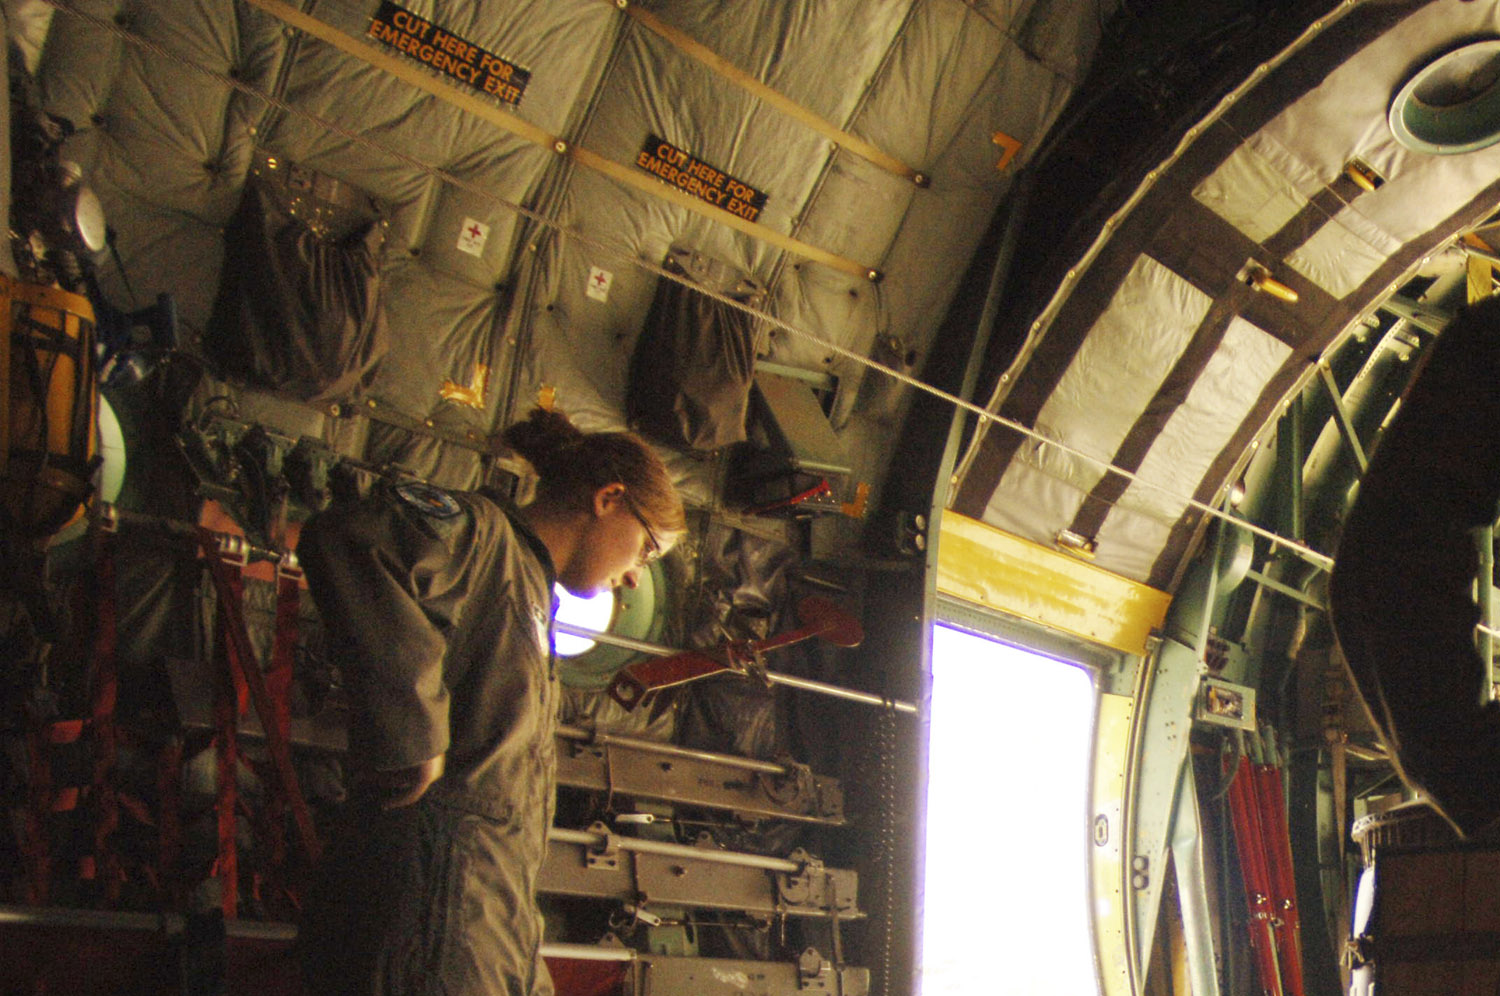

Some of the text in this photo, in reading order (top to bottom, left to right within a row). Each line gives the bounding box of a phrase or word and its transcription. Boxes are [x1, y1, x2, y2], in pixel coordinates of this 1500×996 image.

[369, 19, 521, 103] EMERGENCY EXIT
[393, 11, 514, 82] CUT HERE FOR
[638, 151, 759, 220] EMERGENCY EXIT
[657, 144, 755, 202] CUT HERE FOR
